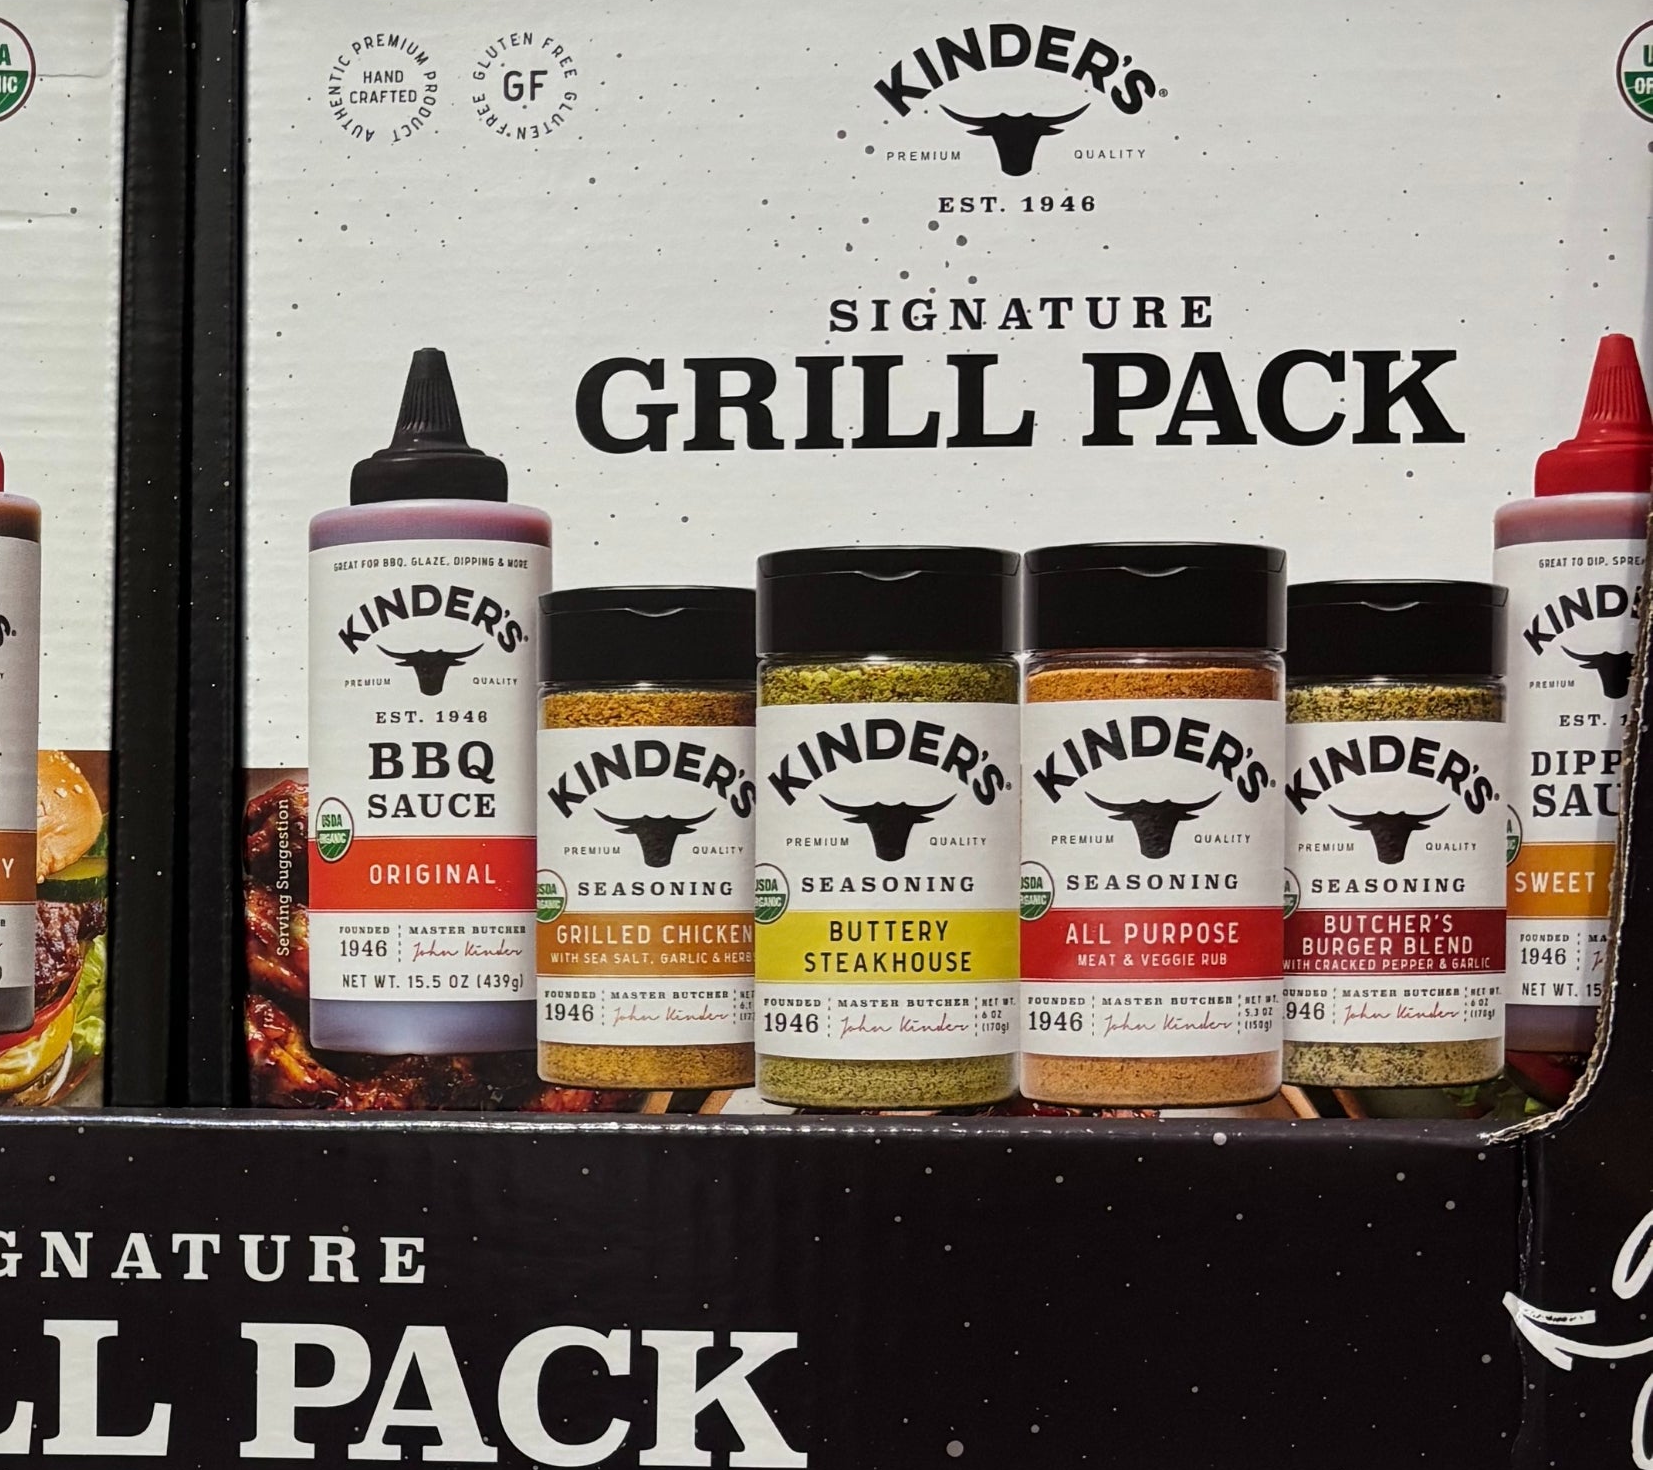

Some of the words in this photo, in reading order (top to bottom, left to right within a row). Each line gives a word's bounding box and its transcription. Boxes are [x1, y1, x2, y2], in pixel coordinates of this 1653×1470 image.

[363, 70, 404, 84] HAND
[874, 23, 1156, 117] KINDER'S
[349, 90, 418, 104] CRAFTED
[503, 70, 548, 102] GF
[937, 197, 1006, 213] EST.
[1021, 196, 1096, 212] 1946
[828, 295, 1217, 334] SIGNATURE
[574, 352, 1036, 454] GRILL
[1081, 348, 1466, 446] PACK
[368, 740, 495, 784] BBQ
[367, 793, 496, 818] SAUCE
[277, 799, 292, 890] Suggestion
[369, 864, 496, 885] ORIGINAL
[1515, 871, 1596, 894] SWEET
[277, 898, 292, 956] Serving
[557, 924, 652, 944] GRILLED
[662, 924, 753, 944] CHICKEN
[829, 920, 949, 942] BUTTERY
[804, 952, 972, 973] STEAKHOUSE
[238, 1321, 809, 1469] PACK
